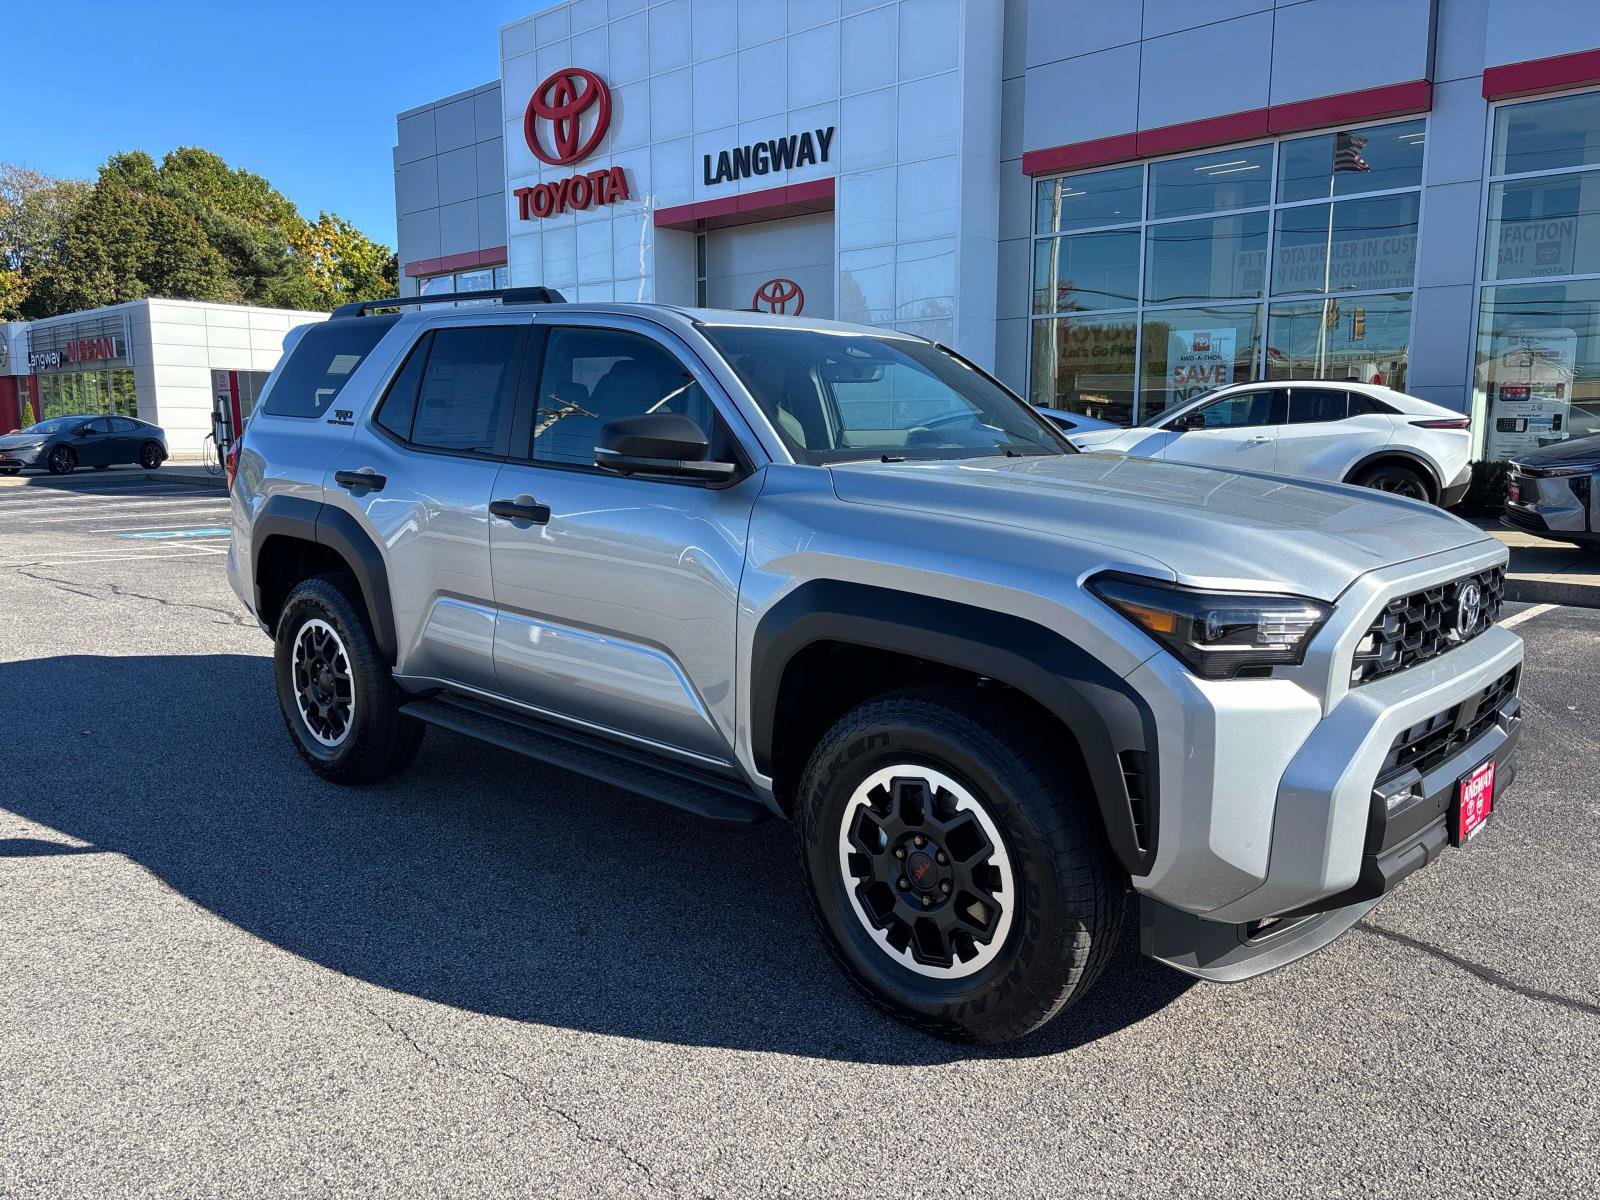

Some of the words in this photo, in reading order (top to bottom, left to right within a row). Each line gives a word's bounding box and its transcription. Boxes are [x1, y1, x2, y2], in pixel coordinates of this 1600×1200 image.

[703, 126, 835, 186] LANGWAY
[513, 166, 630, 220] TOYOTA
[1257, 247, 1305, 268] TOTA
[1331, 258, 1401, 278] NGLAND...
[1061, 321, 1151, 343] TOYOT
[27, 351, 62, 369] Langway
[66, 335, 117, 362] NISSAN
[1092, 345, 1108, 357] Go
[1110, 343, 1151, 357] Plac
[1173, 364, 1226, 384] SAVE
